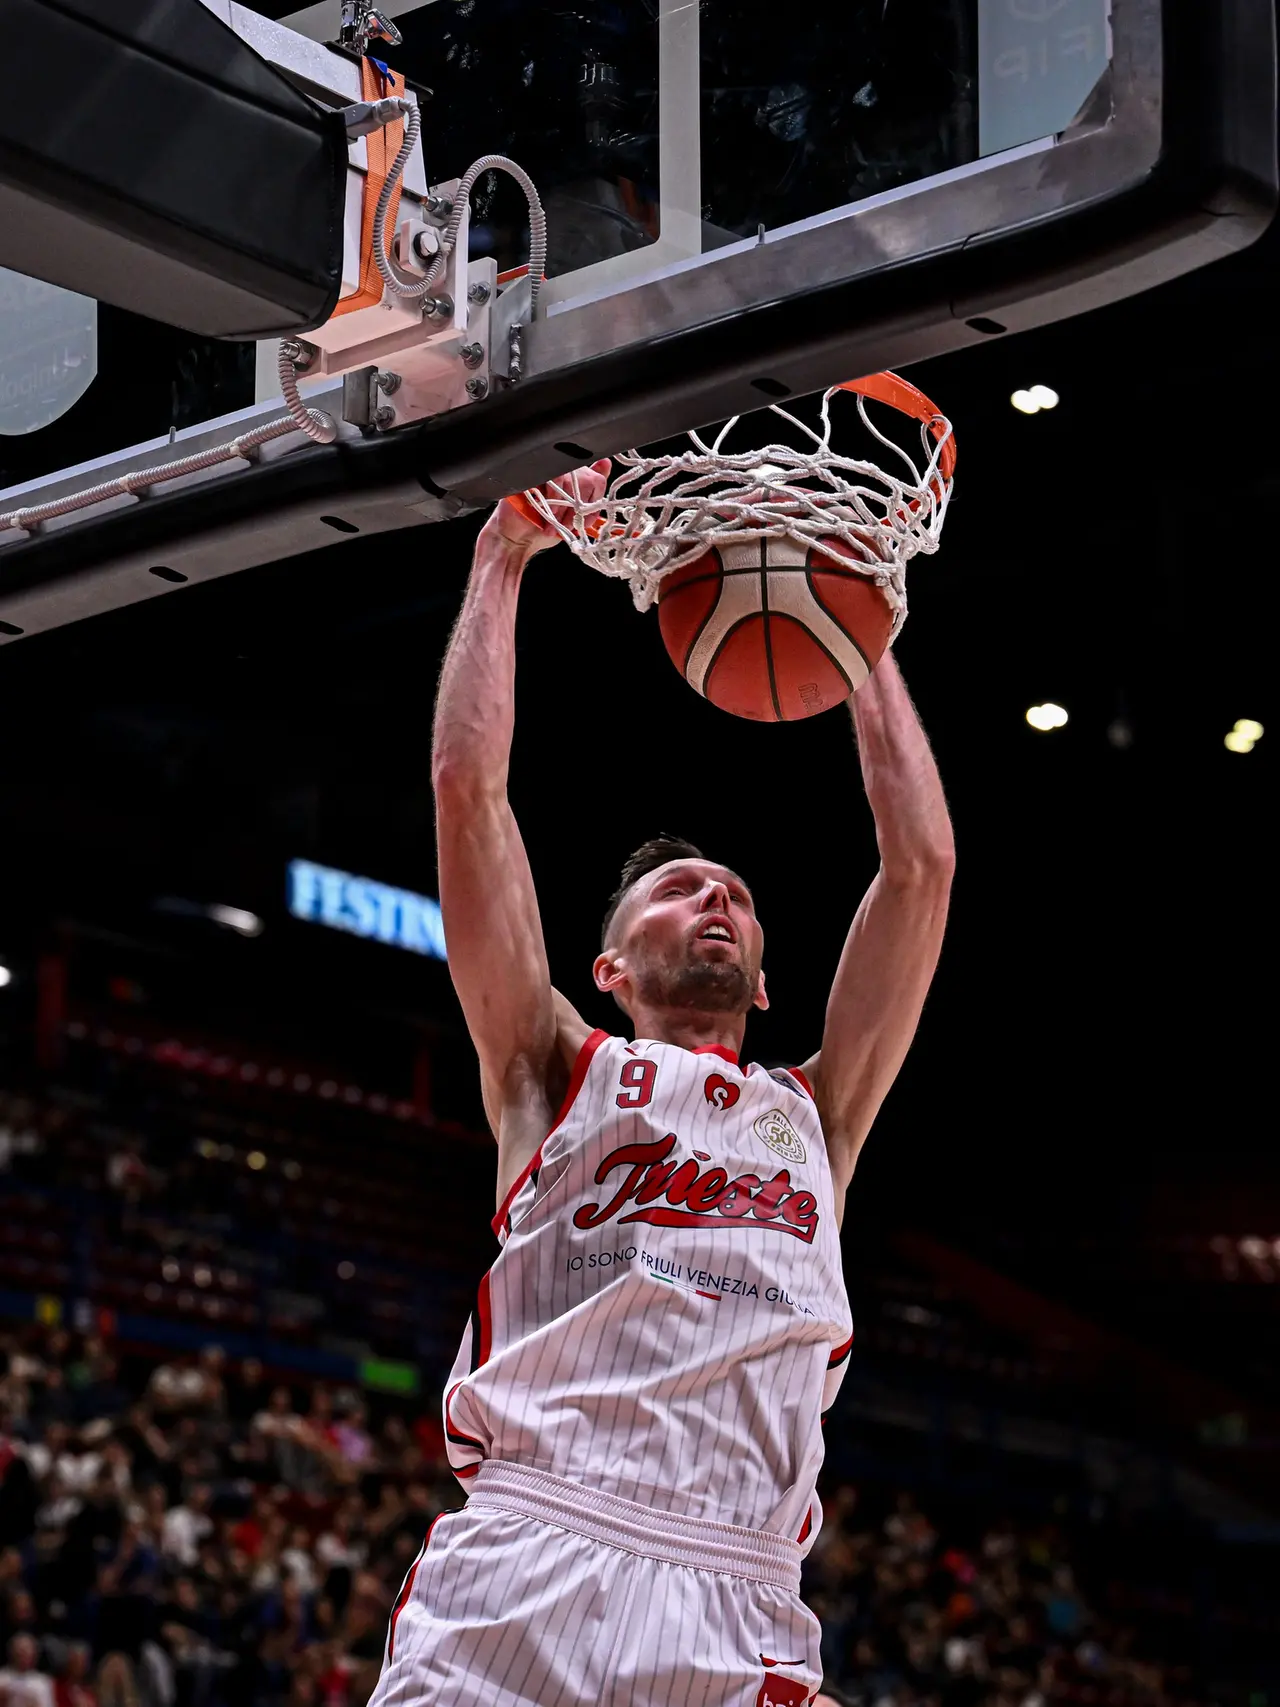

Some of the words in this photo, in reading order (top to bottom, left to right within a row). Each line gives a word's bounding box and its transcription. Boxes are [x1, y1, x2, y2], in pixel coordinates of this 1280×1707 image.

[616, 1059, 658, 1109] 9
[769, 1126, 792, 1146] 50
[573, 1133, 820, 1244] Trieste
[566, 1256, 584, 1273] IO
[588, 1246, 638, 1268] SONO
[640, 1250, 682, 1279] FRIULI
[687, 1267, 759, 1299] VENEZIA
